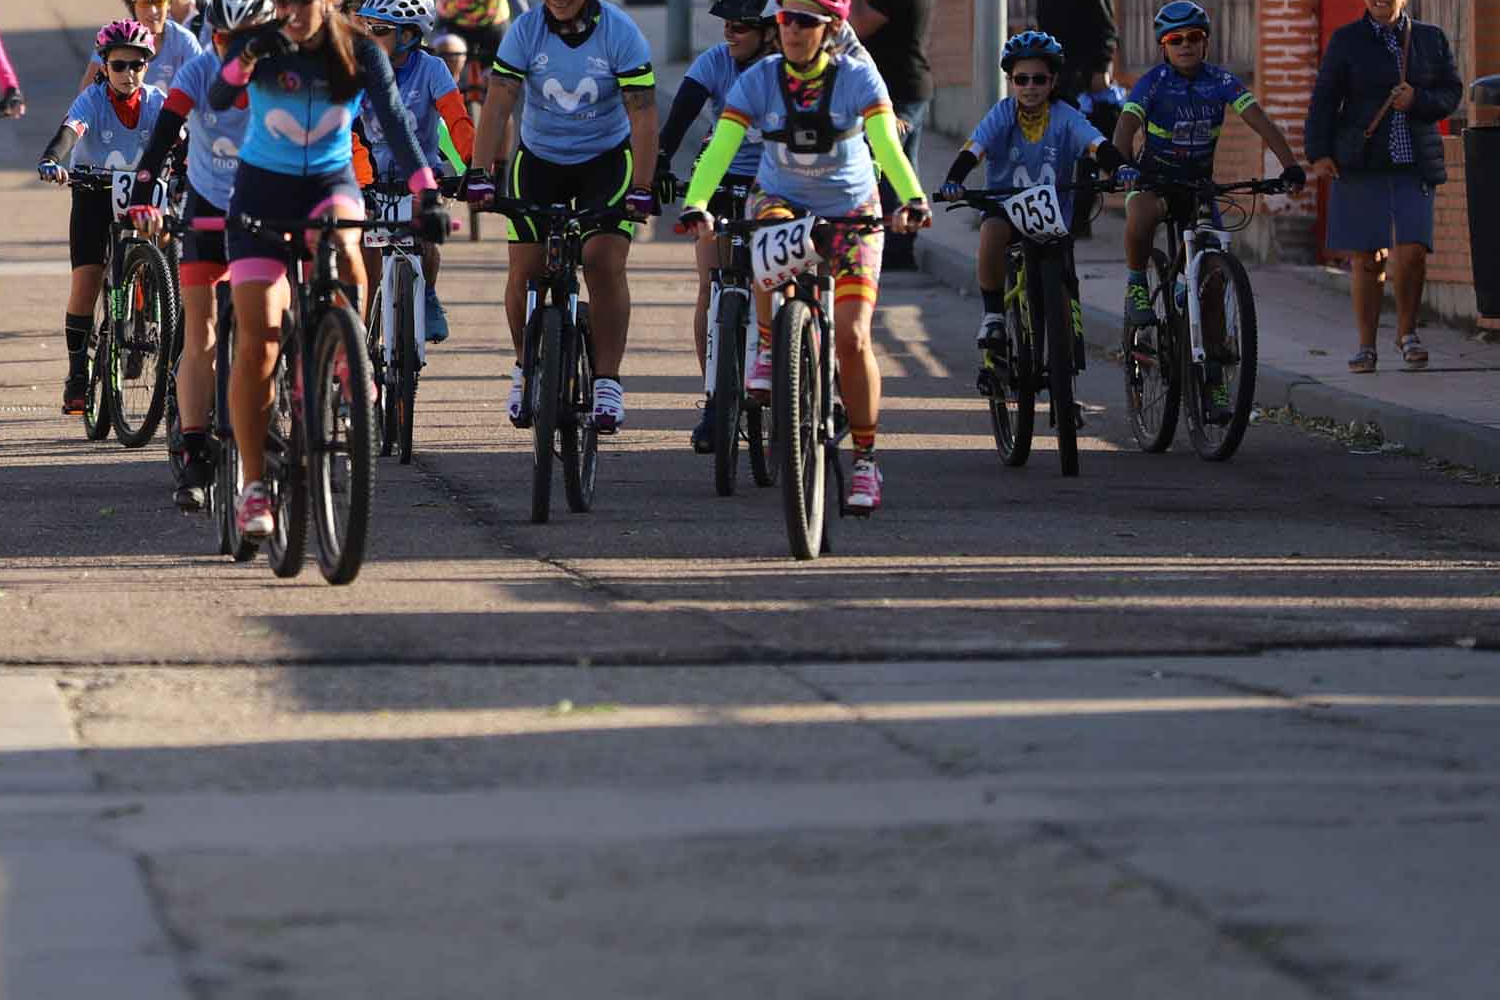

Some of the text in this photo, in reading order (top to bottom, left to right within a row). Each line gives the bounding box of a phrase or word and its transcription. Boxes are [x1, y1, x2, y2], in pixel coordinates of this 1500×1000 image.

[116, 174, 164, 209] 30
[1011, 189, 1056, 234] 253
[757, 223, 805, 271] 139
